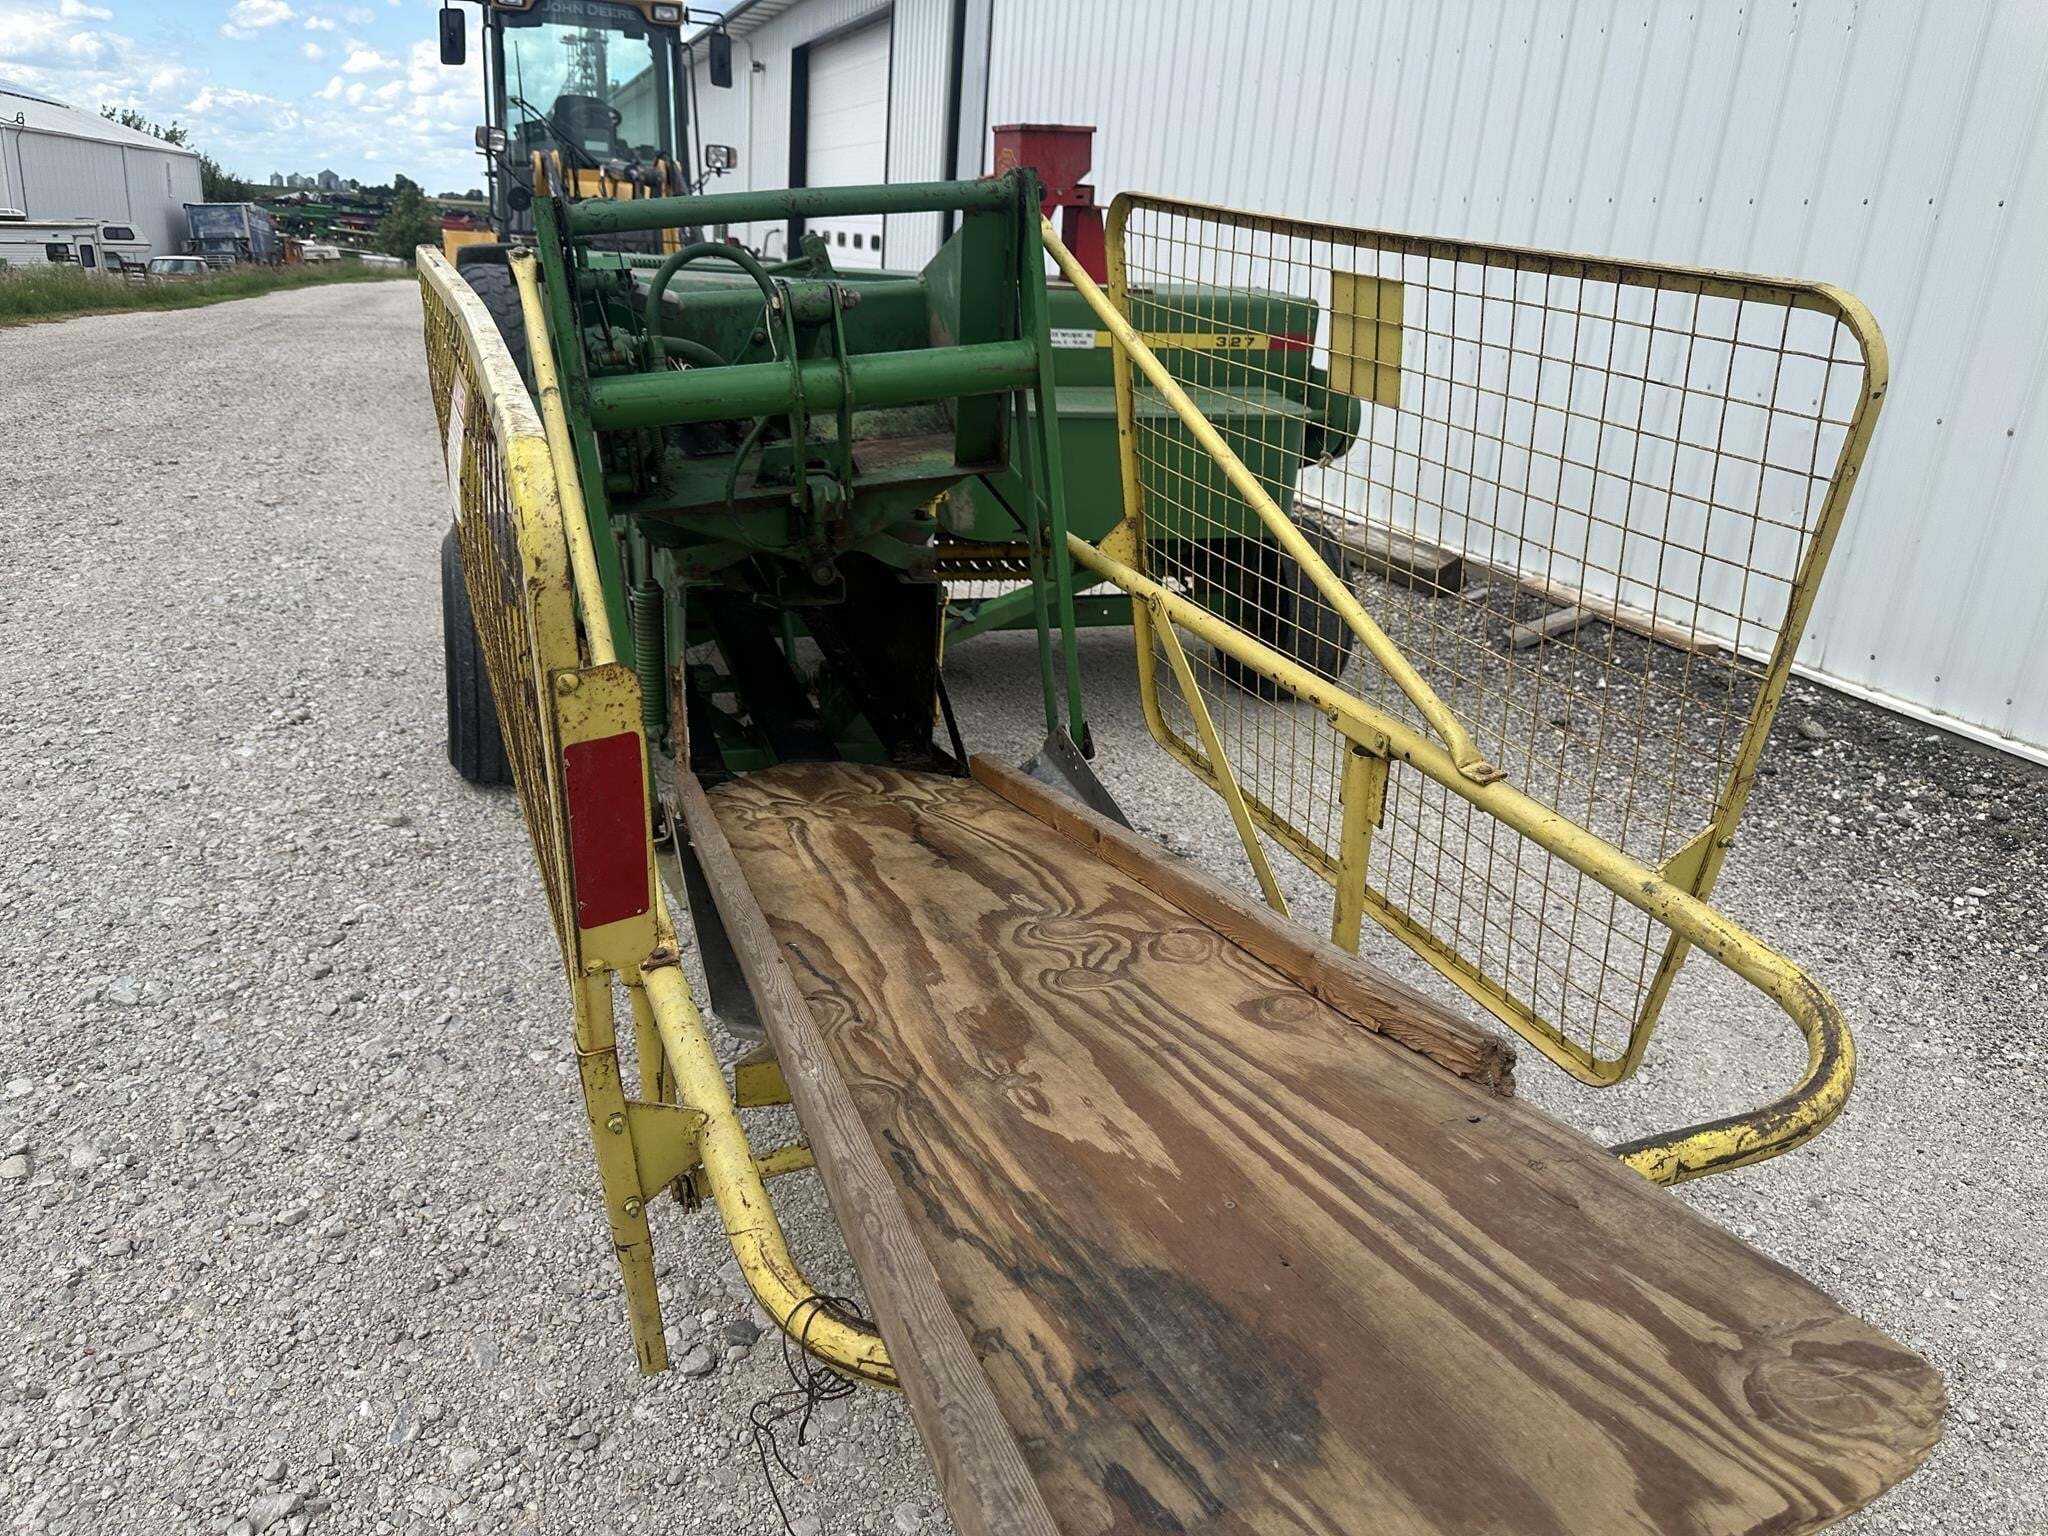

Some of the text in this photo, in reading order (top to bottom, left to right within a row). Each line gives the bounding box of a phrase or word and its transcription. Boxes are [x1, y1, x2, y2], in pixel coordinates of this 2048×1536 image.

[542, 2, 637, 20] JOHN DEERE
[1215, 336, 1255, 348] 327
